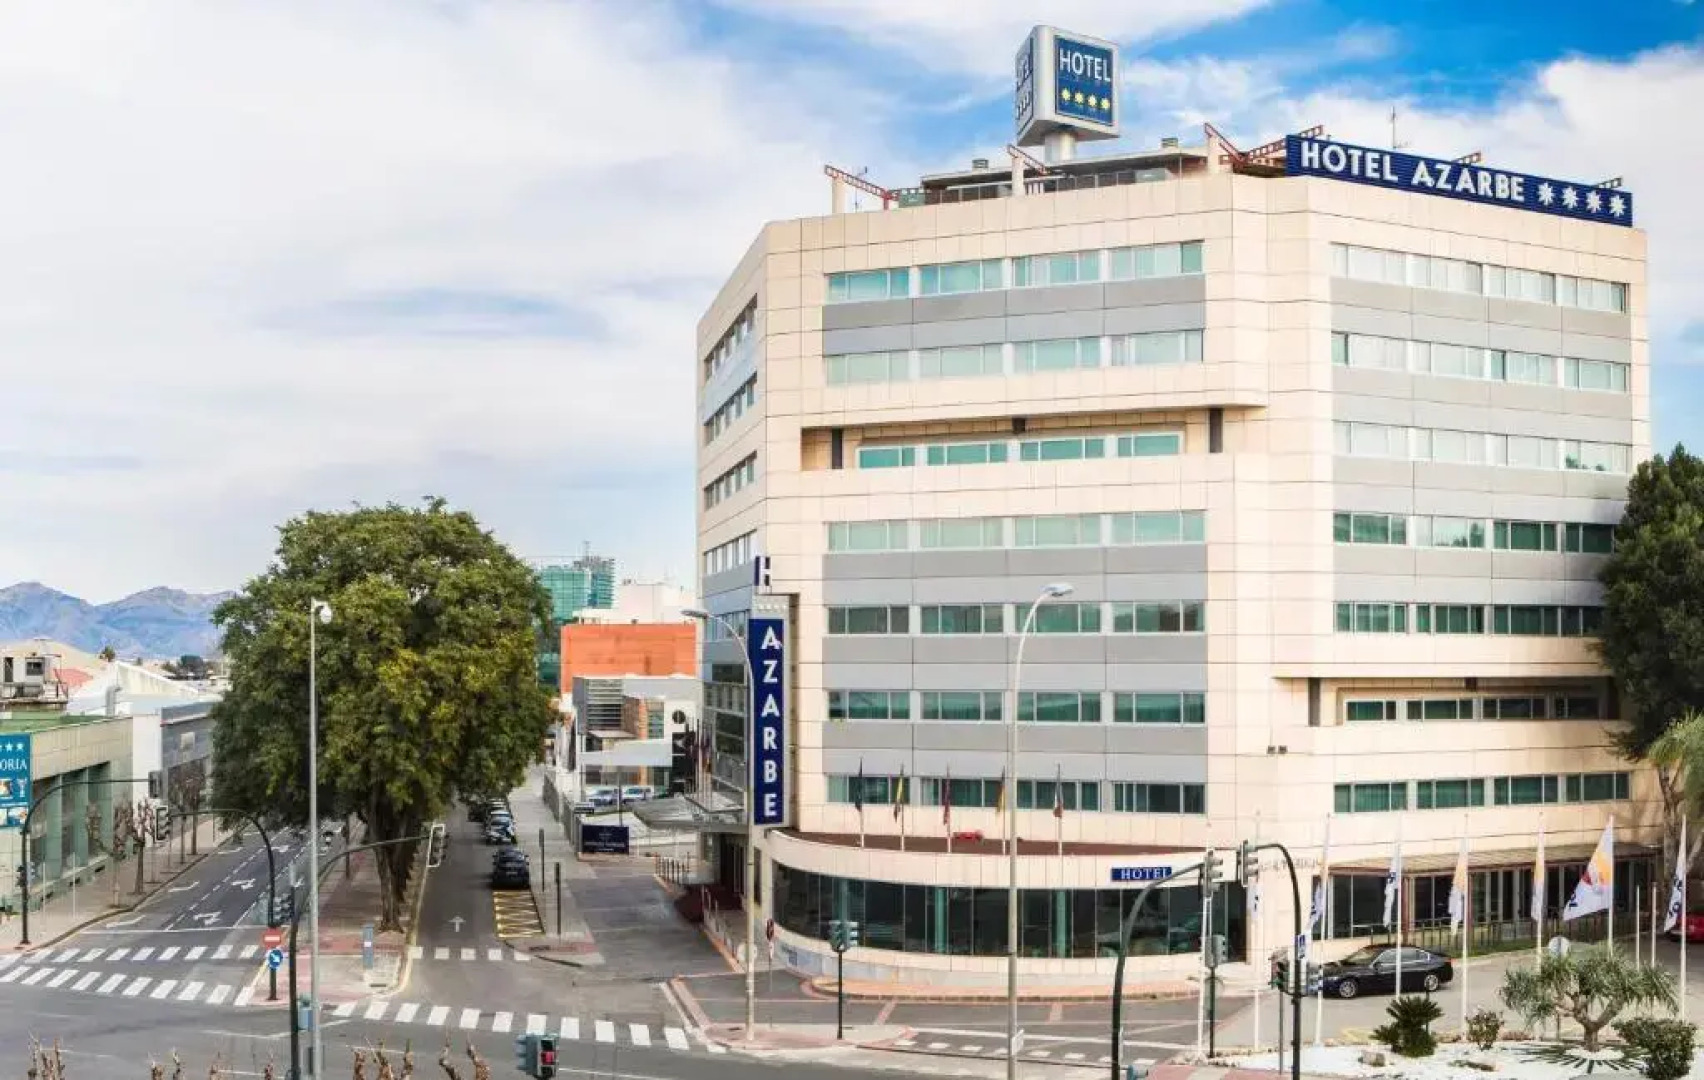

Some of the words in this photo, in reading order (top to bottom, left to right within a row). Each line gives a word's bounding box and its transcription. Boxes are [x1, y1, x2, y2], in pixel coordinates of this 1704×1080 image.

[1059, 48, 1110, 82] HOTEL
[1301, 140, 1398, 182] HOTEL
[1410, 159, 1525, 201] AZARBE
[760, 625, 782, 817] AZARBE
[1121, 867, 1171, 880] HOTEL
